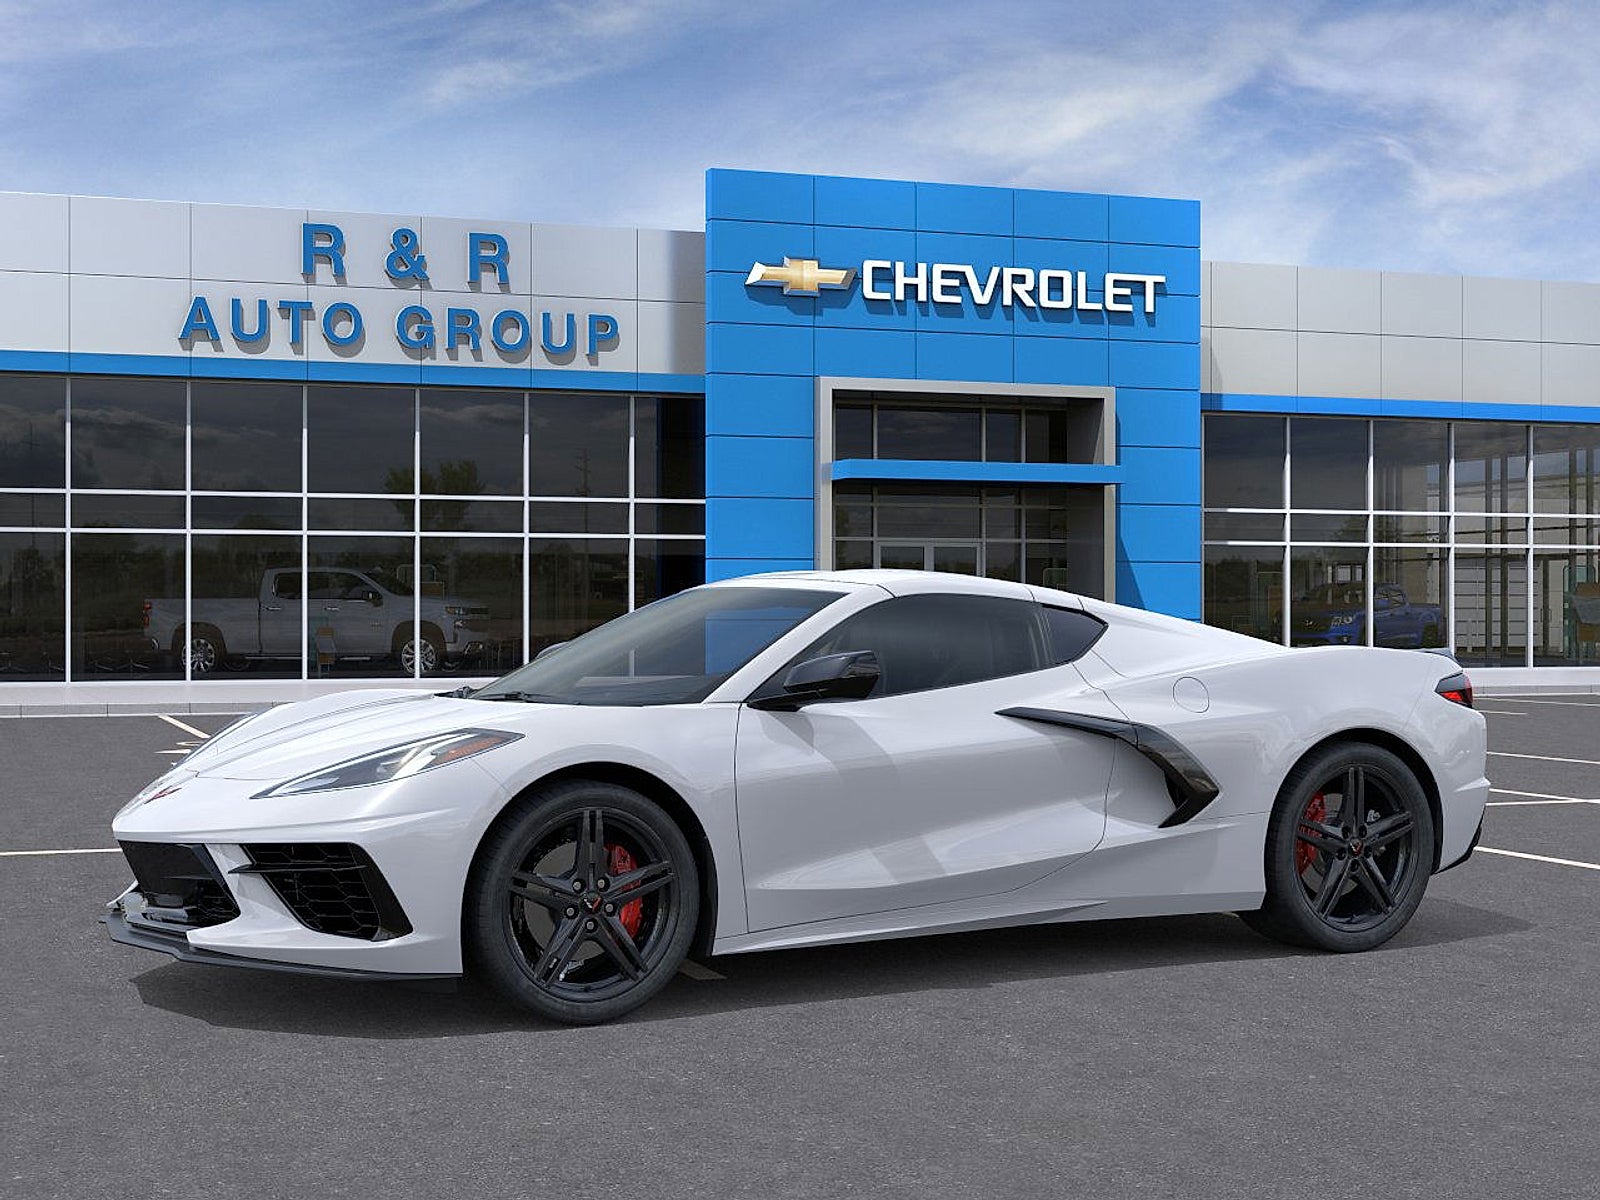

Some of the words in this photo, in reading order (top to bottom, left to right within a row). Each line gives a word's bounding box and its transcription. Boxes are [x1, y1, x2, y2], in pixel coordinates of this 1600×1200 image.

[302, 222, 345, 278] R
[385, 227, 429, 280] &
[467, 232, 509, 284] R
[862, 259, 1166, 313] CHEVROLET
[179, 295, 363, 346] AUTO
[396, 304, 619, 357] GROUP
